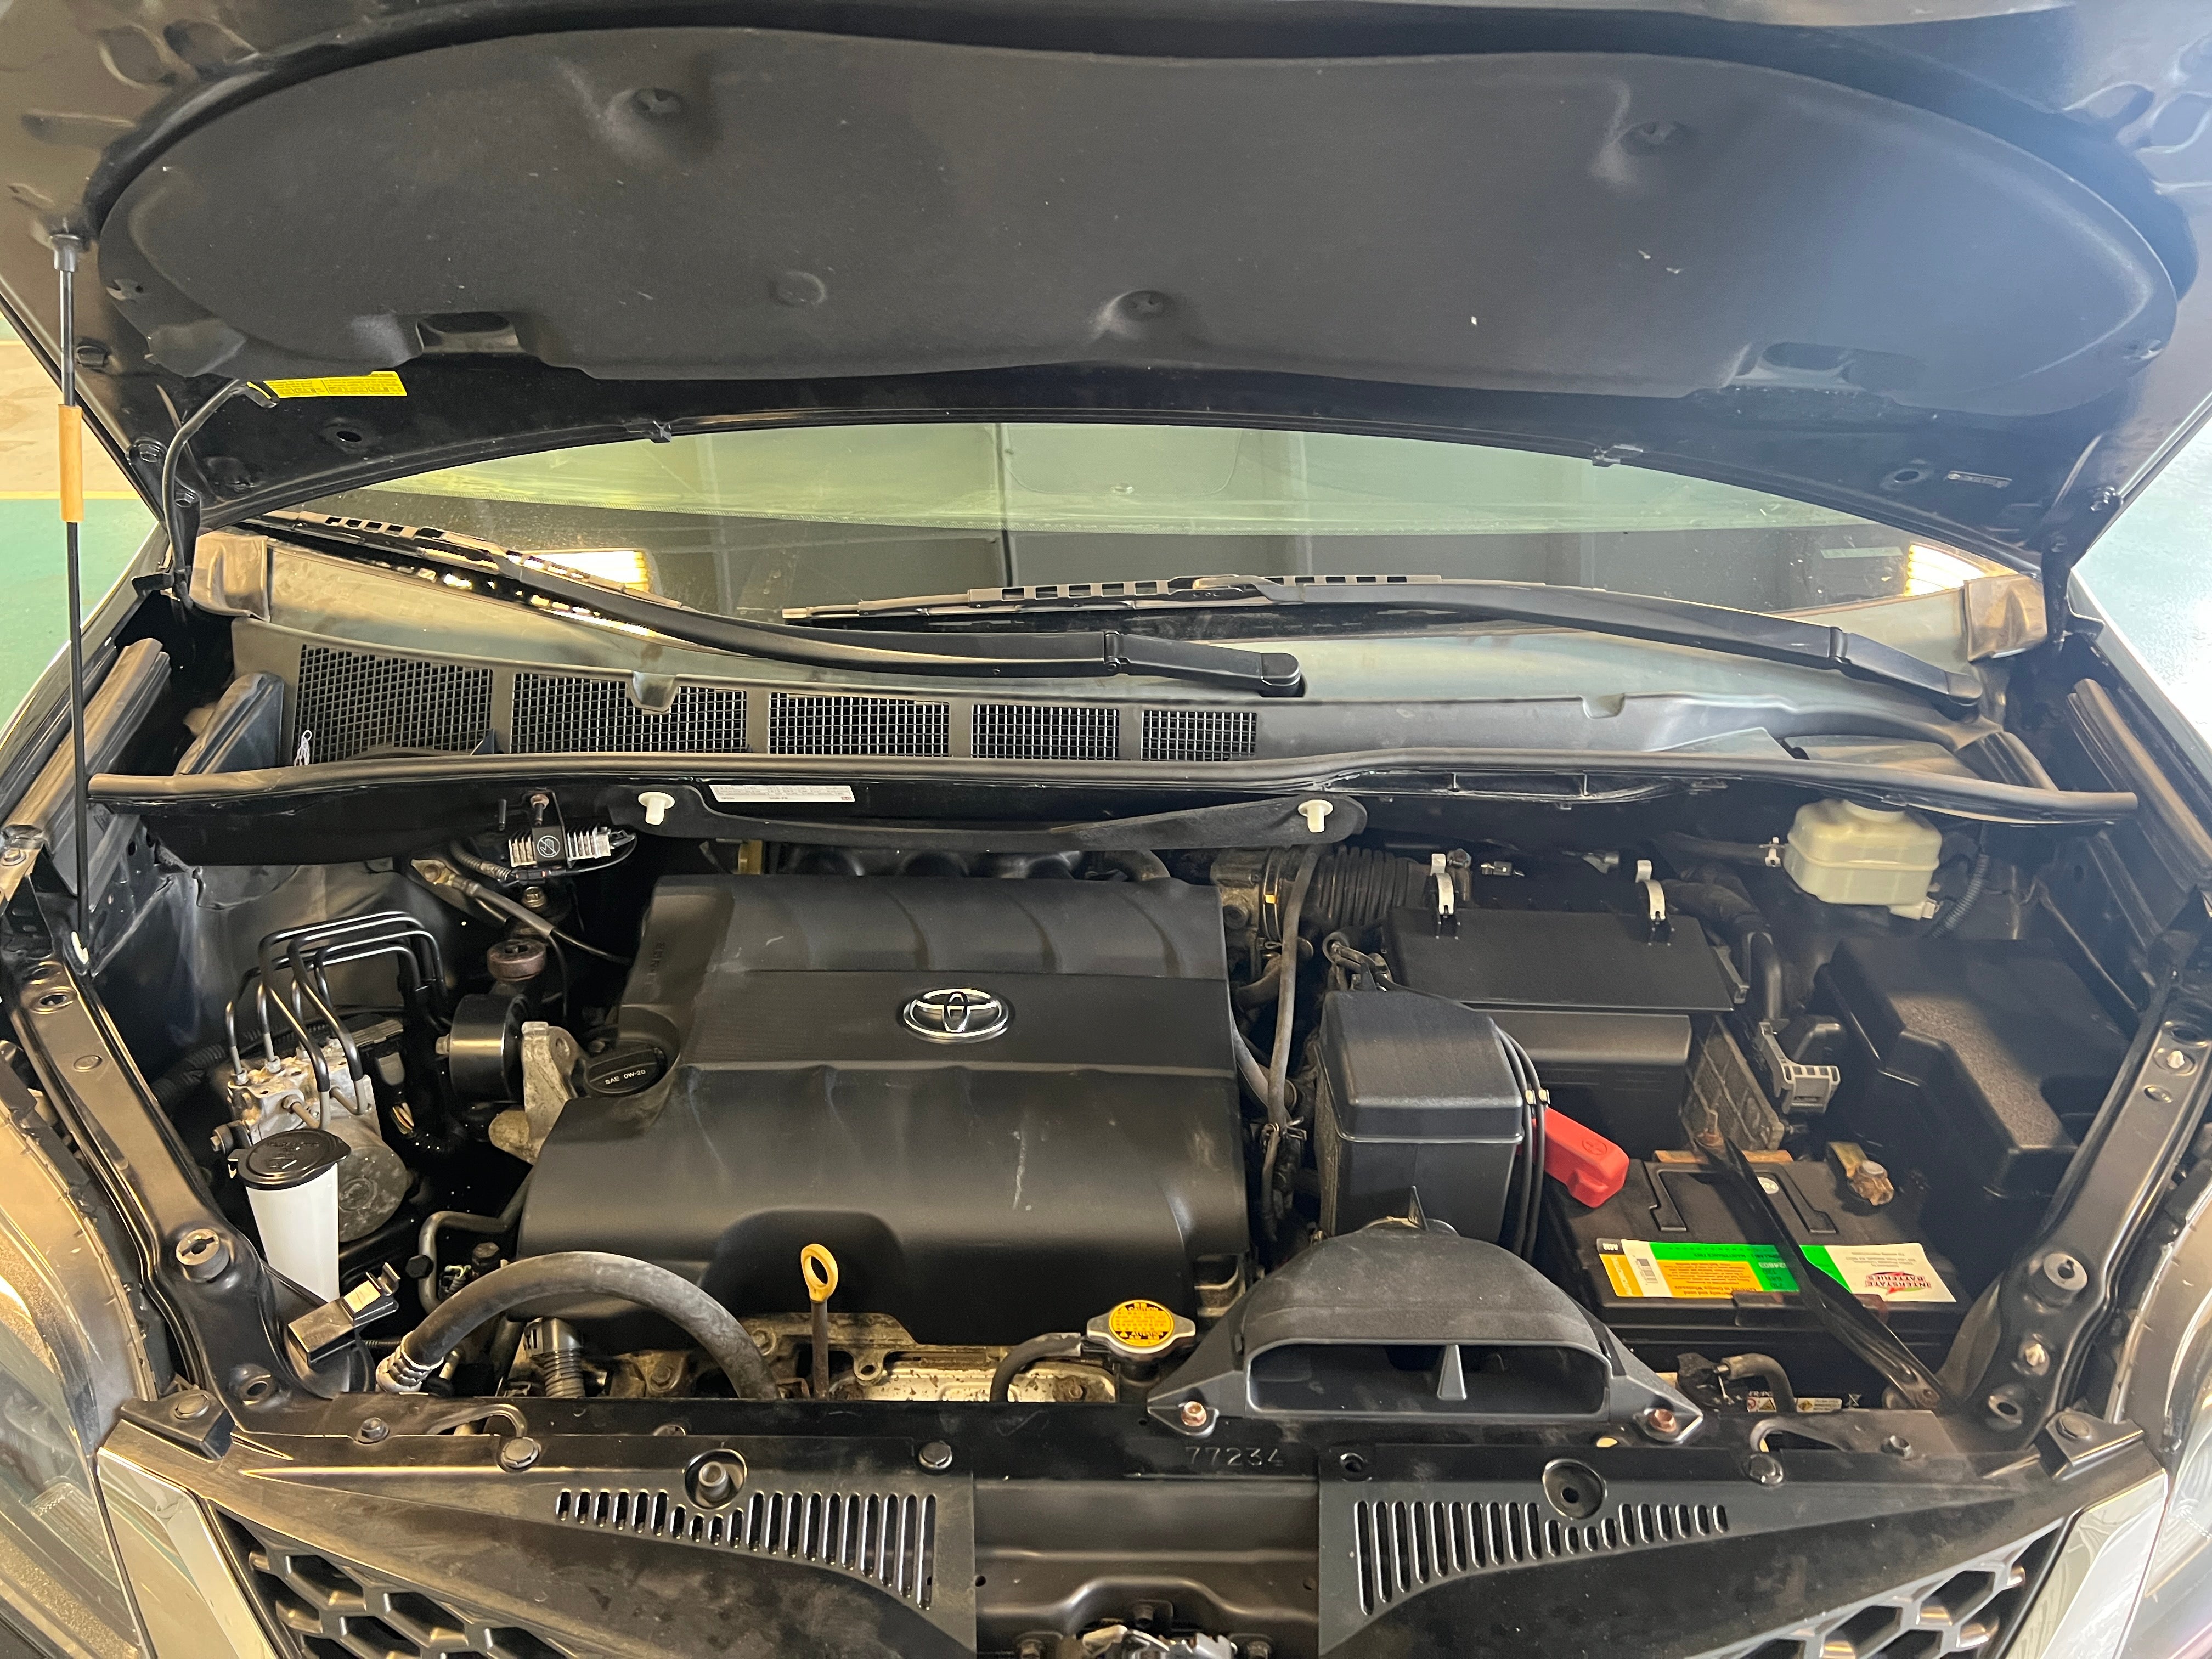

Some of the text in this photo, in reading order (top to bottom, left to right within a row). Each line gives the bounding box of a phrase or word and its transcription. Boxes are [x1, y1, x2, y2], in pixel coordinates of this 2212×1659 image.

[605, 1069, 646, 1085] SAE 0W-20
[1865, 1281, 1932, 1289] INTERSTATE
[1185, 1446, 1284, 1467] 77234
